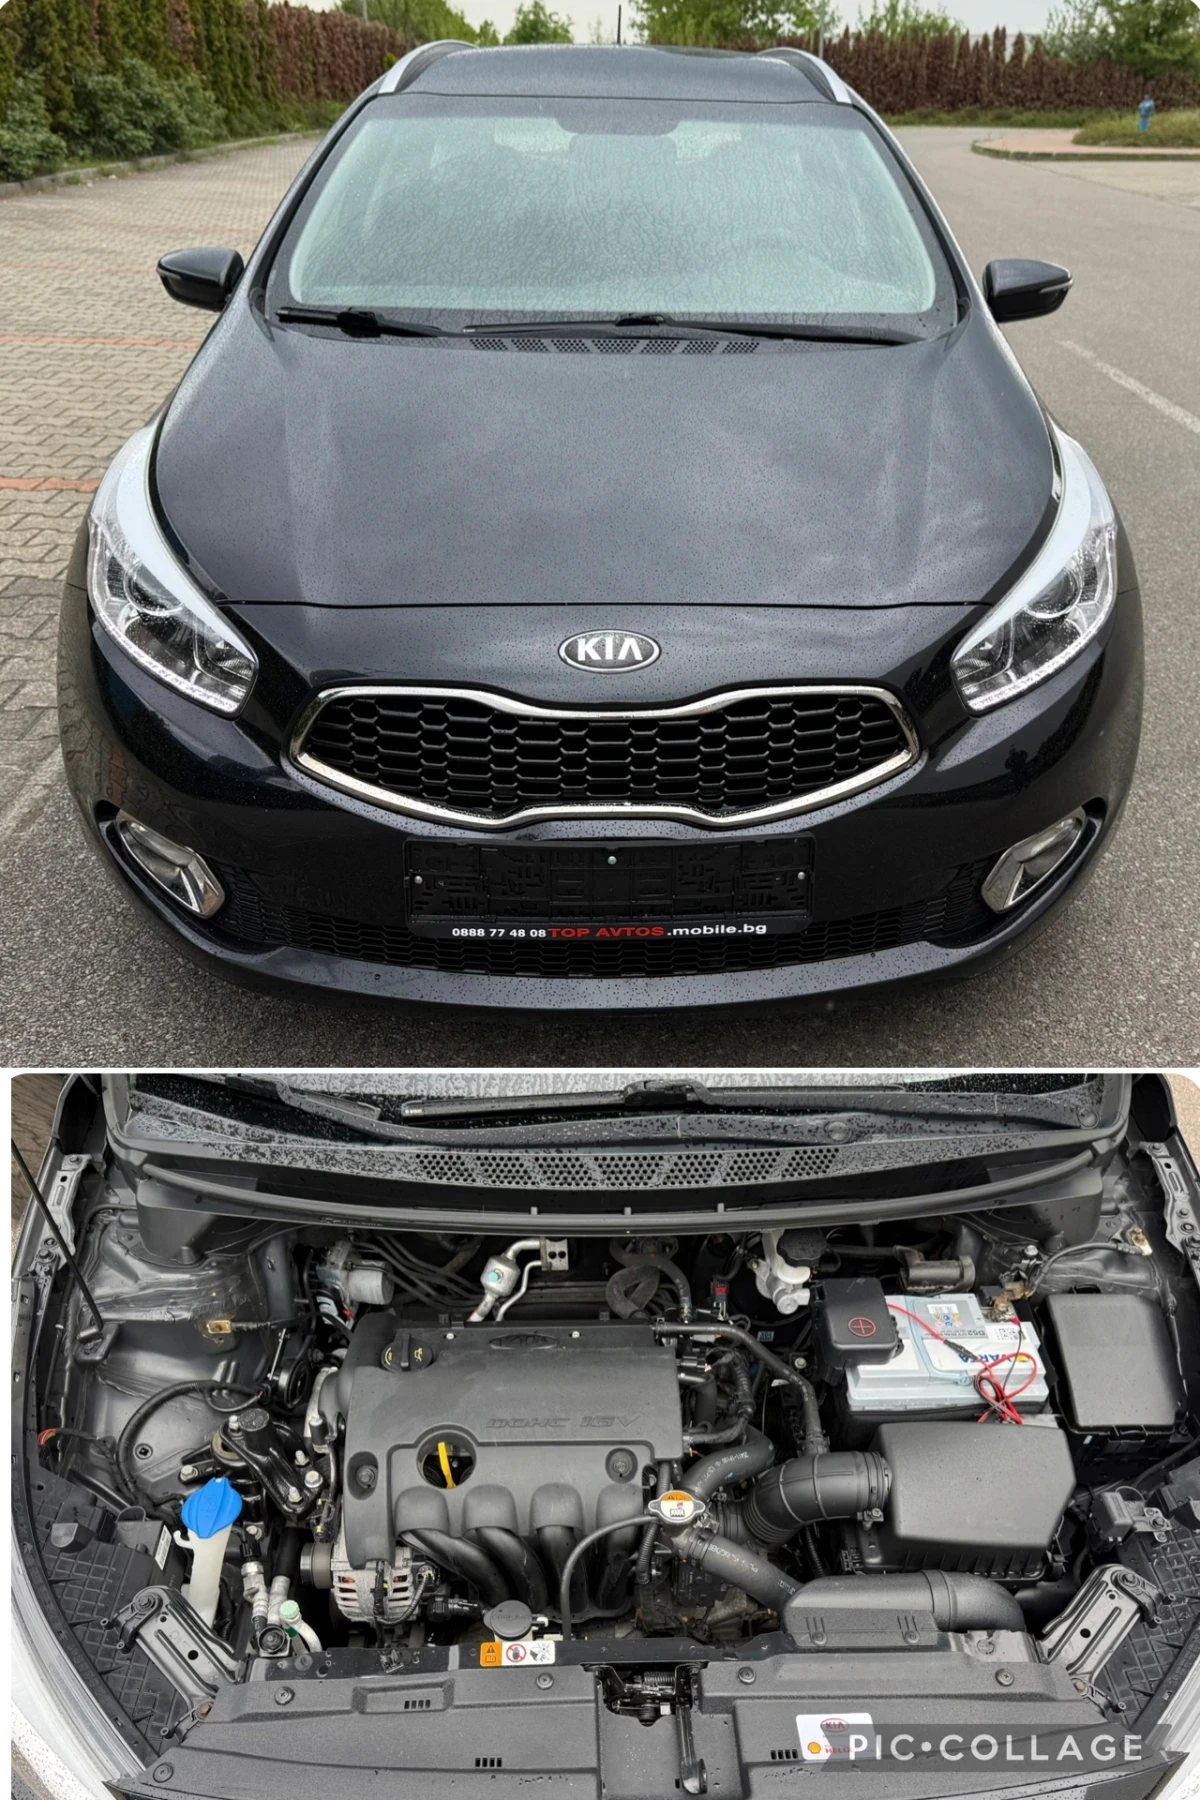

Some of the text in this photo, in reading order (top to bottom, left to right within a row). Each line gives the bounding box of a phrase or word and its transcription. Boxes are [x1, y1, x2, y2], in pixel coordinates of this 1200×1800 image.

[577, 636, 643, 661] KIA
[452, 923, 767, 938] 0888 77 48 08 TOP AVTOS .mobile.bg
[486, 1415, 641, 1428] DOHC 16V
[825, 1721, 846, 1730] KIA
